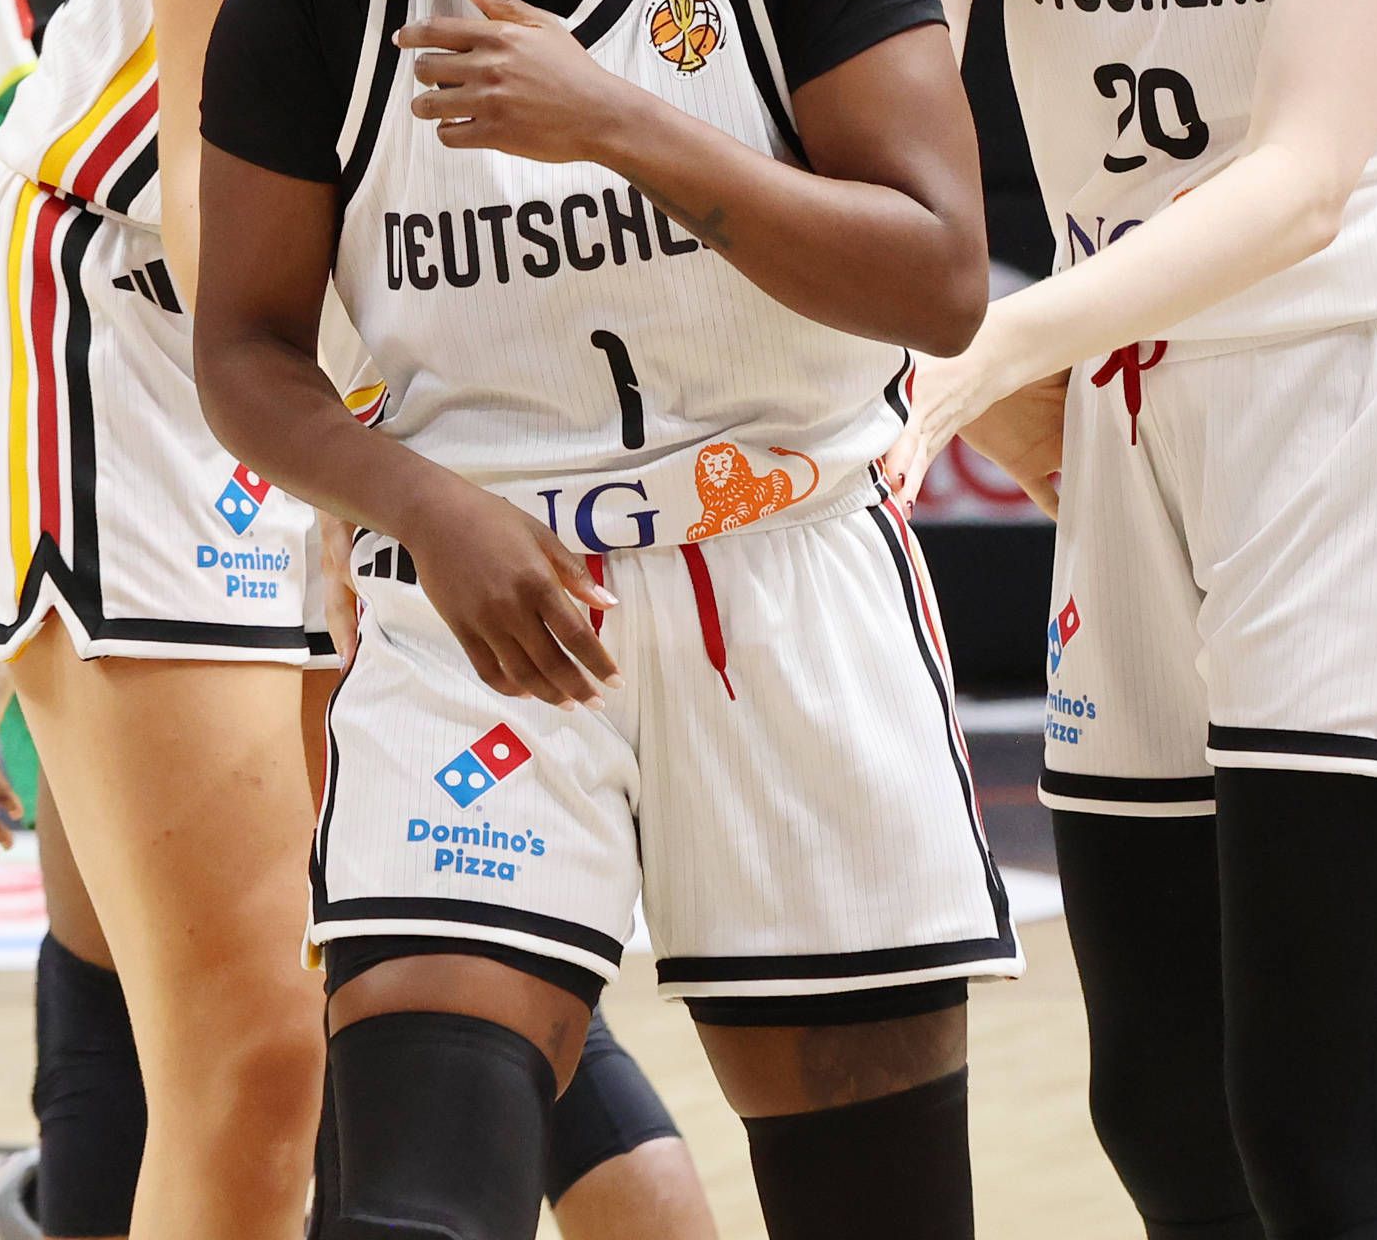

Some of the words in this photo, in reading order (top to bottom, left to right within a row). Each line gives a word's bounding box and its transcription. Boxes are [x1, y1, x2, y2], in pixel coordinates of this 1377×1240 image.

[1093, 62, 1210, 174] 20
[384, 184, 712, 291] DEUTSCHL
[590, 329, 645, 450] 1
[197, 544, 290, 571] Domino's
[226, 574, 277, 598] Pizza
[1048, 689, 1096, 720] mino's
[407, 818, 546, 857] Domino's
[434, 848, 515, 882] Pizza
